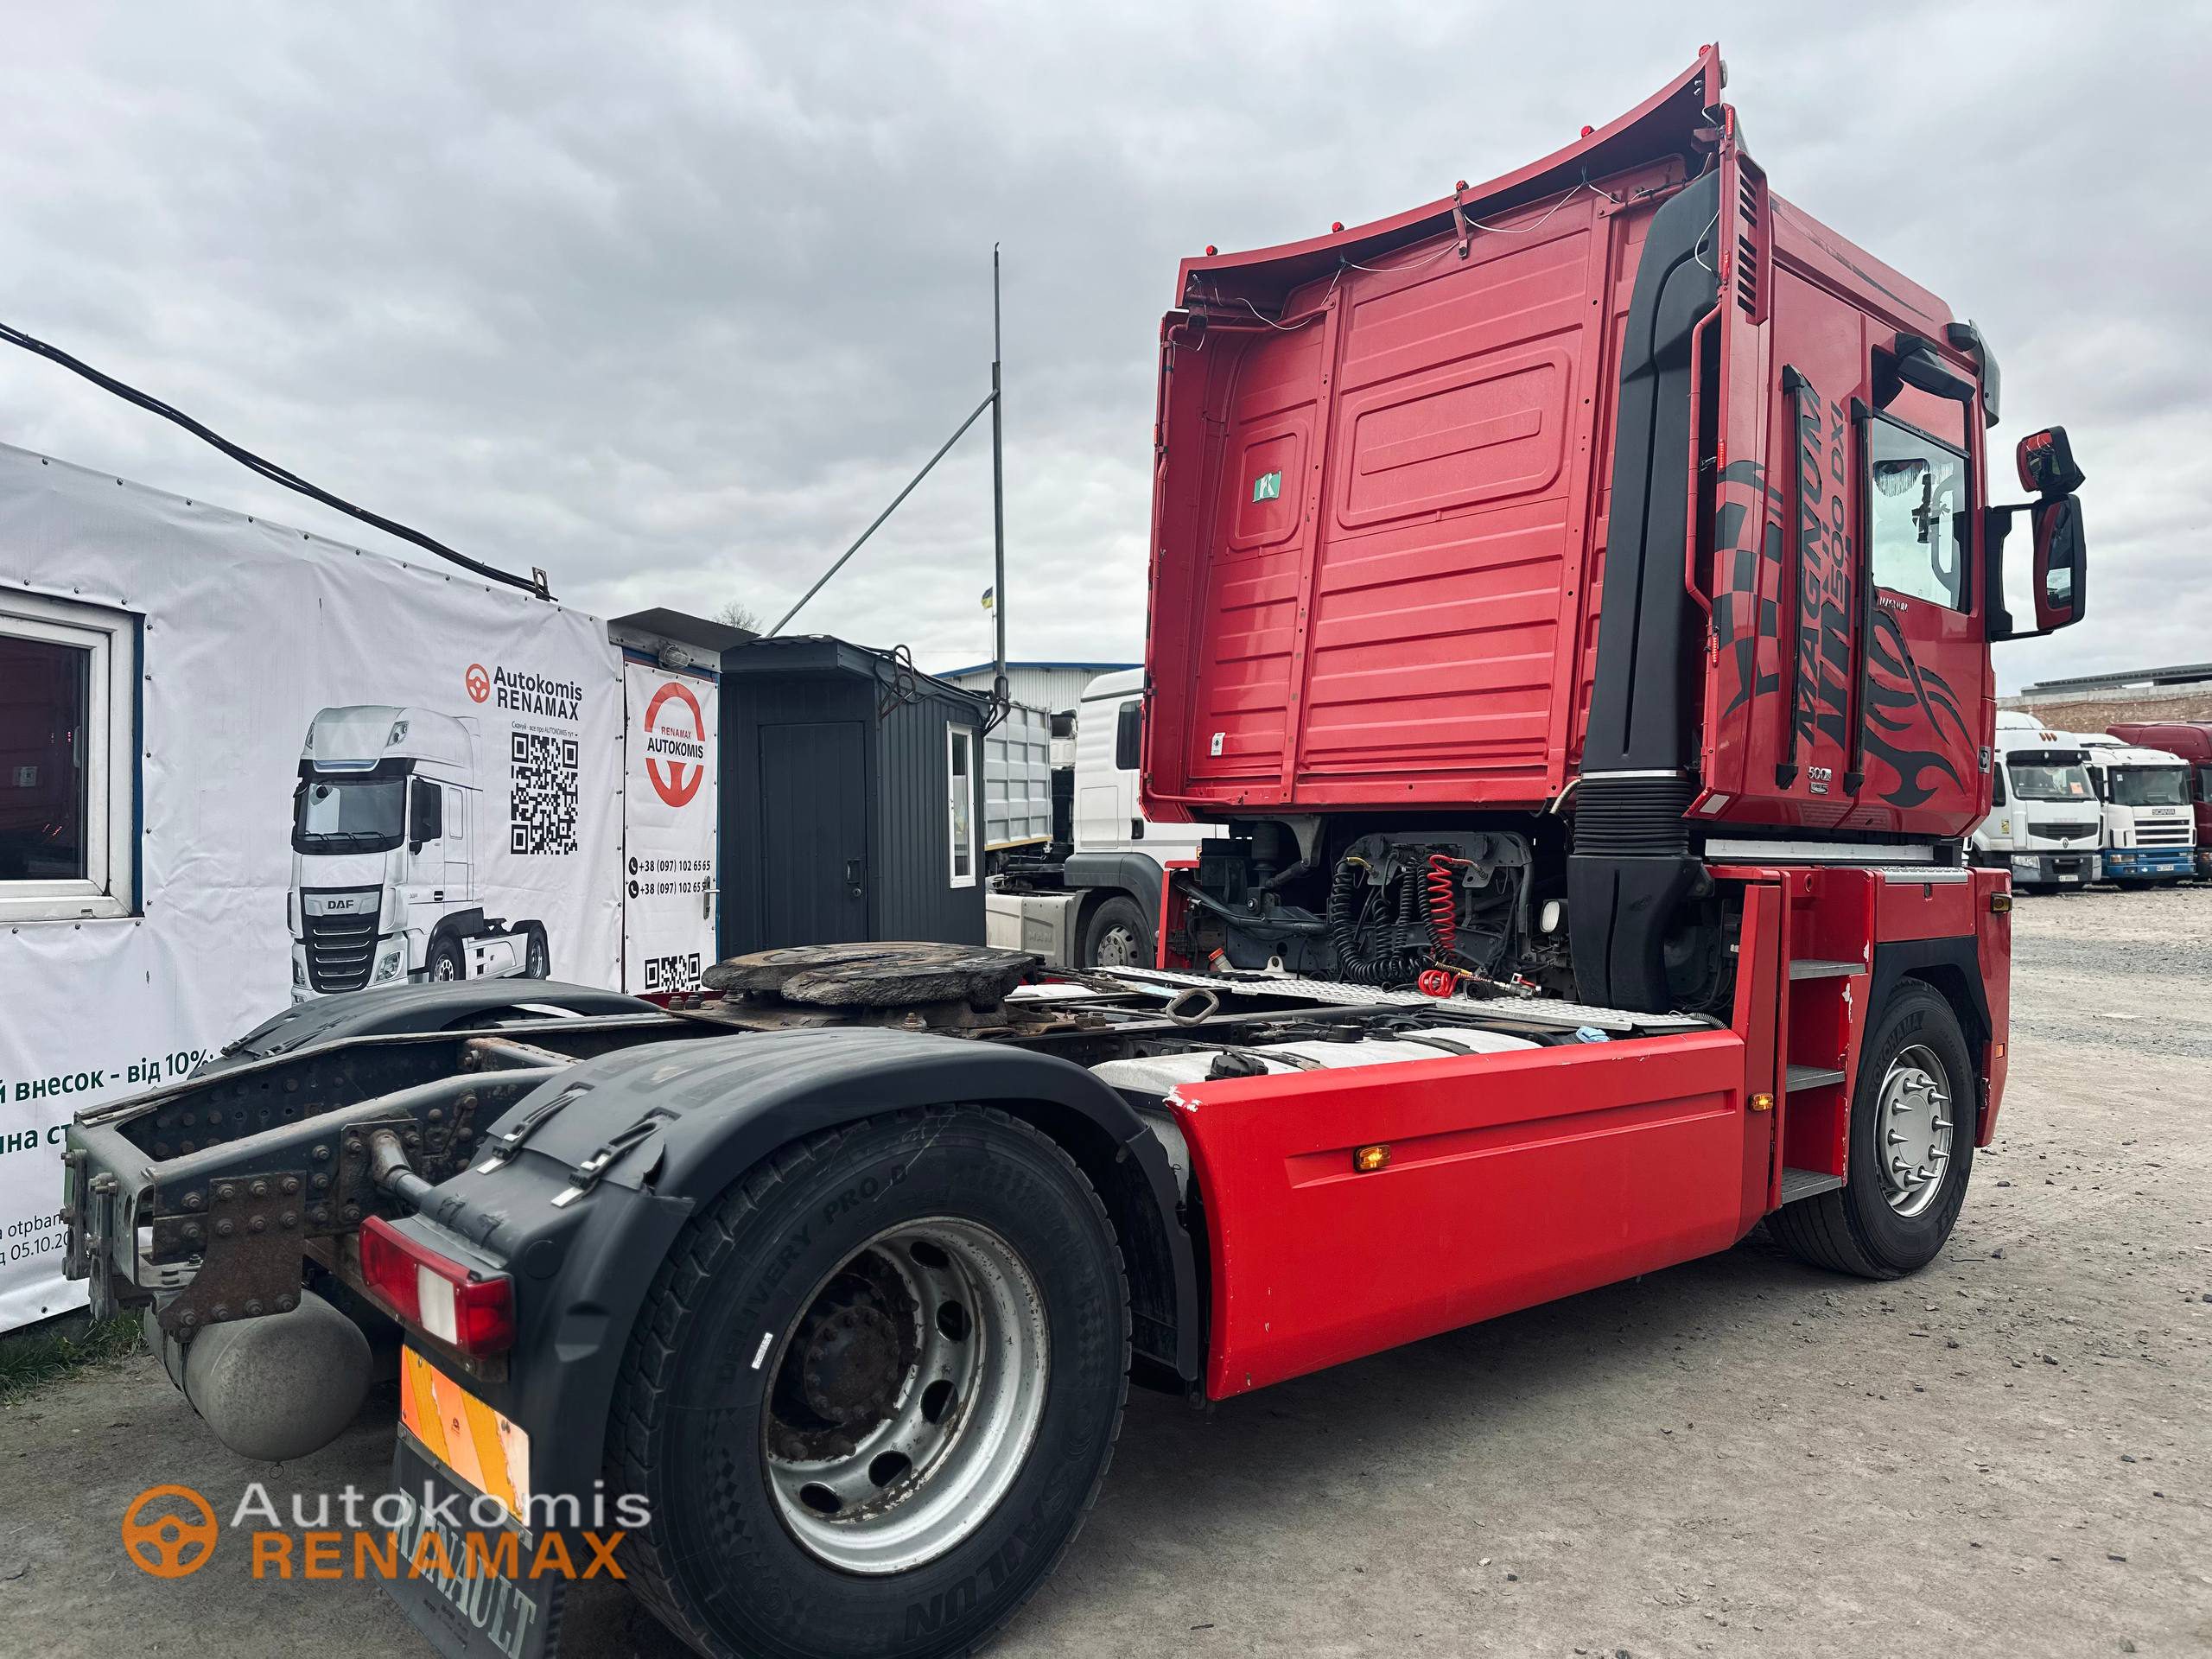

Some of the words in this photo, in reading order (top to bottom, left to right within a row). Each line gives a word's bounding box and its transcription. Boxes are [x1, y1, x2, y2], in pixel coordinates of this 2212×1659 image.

[1796, 378, 1822, 748] MAGNUM
[1831, 494, 1846, 615] 500
[493, 665, 582, 701] Autokomis
[497, 687, 579, 721] RENAMAX
[647, 737, 703, 759] AUTOKOMIS
[661, 727, 691, 740] RENAMAX
[639, 861, 654, 872] +38
[657, 859, 677, 873] (097)
[679, 861, 691, 871] 102
[327, 899, 354, 909] DAF
[640, 883, 654, 894] +38
[657, 881, 677, 895] (097)
[679, 882, 691, 893] 102
[15, 1070, 105, 1102] внесок
[127, 1057, 161, 1084] від
[822, 1176, 880, 1225] PRO
[389, 1486, 537, 1659] RENAULT
